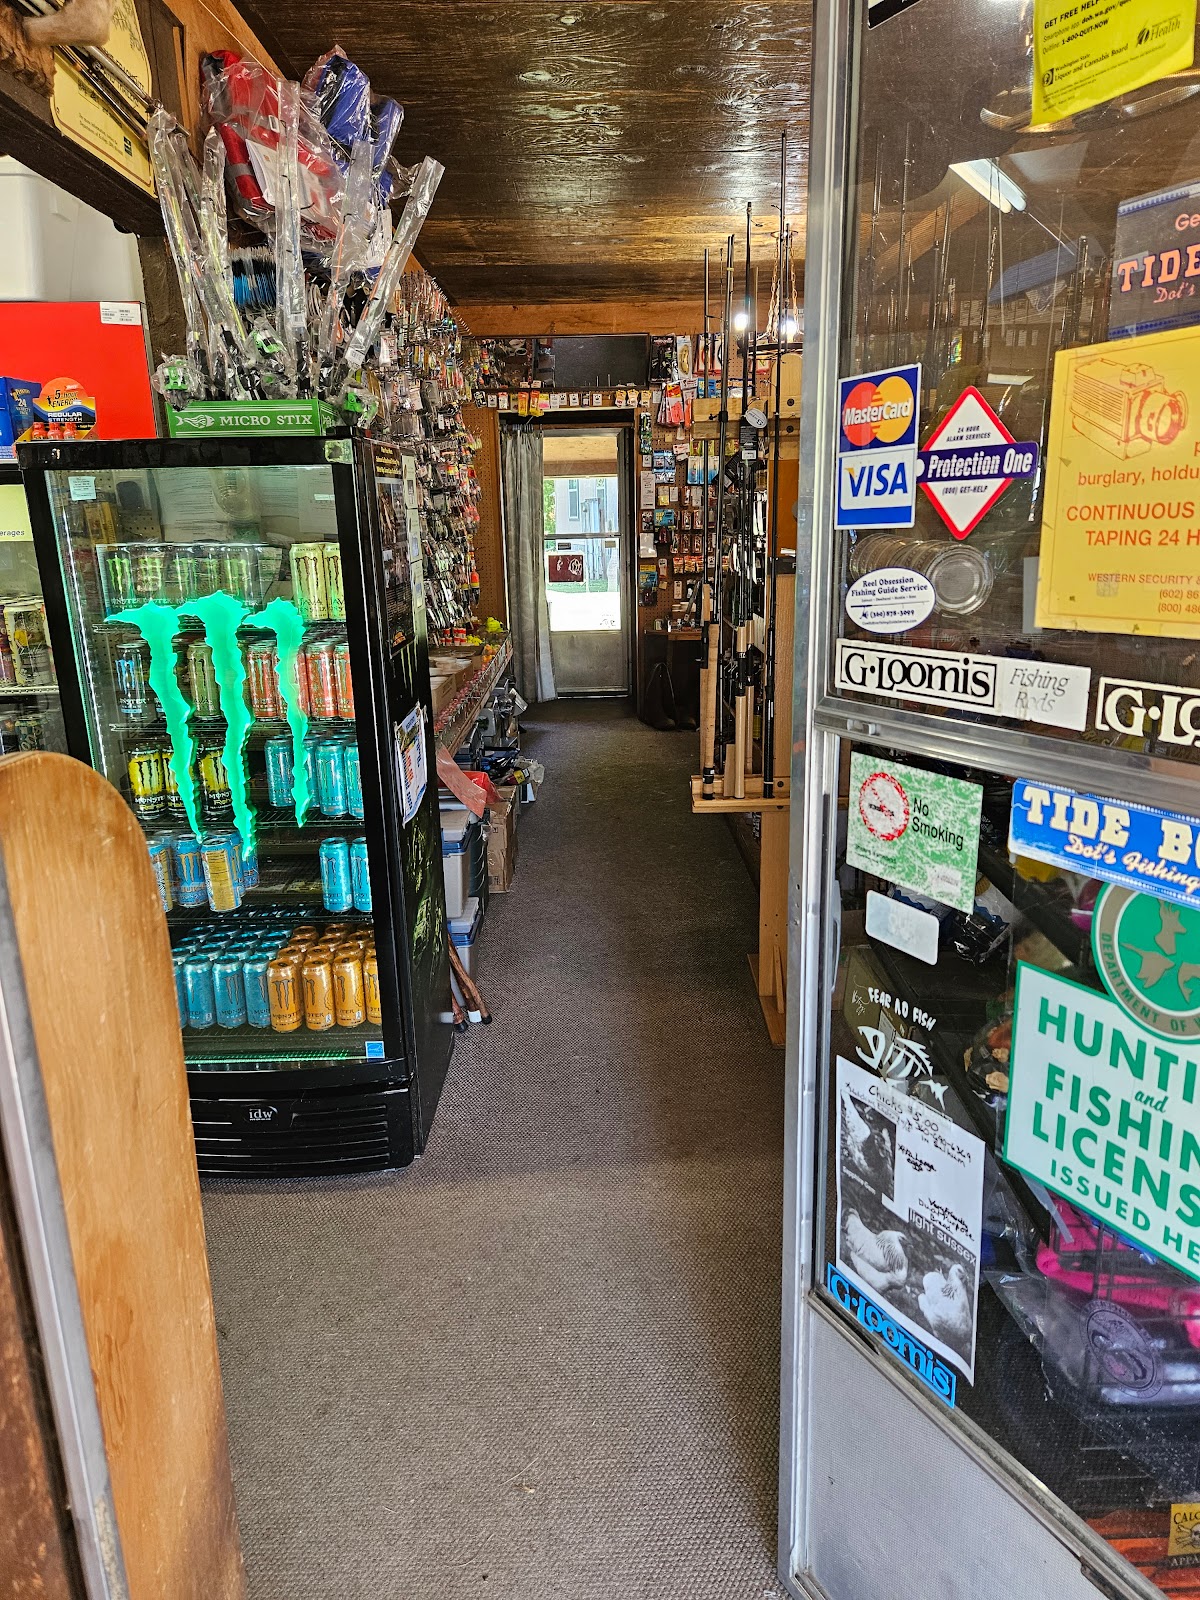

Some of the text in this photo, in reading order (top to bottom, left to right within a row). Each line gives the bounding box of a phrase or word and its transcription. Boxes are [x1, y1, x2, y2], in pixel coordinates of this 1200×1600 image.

[1044, 16, 1059, 30] GET
[1060, 6, 1079, 22] FREE
[1150, 18, 1182, 41] Health
[1061, 18, 1109, 46] 1-800-QUIT-NOW
[1054, 69, 1073, 82] Liquor
[1073, 64, 1084, 75] and
[1084, 52, 1110, 69] Cannabis
[1111, 43, 1129, 57] Board
[1055, 56, 1080, 72] Washington
[1117, 243, 1200, 293] TIDE
[1153, 281, 1196, 304] Dot's
[219, 415, 271, 427] MICRO
[276, 414, 313, 425] STIX
[844, 397, 913, 427] MasterCard
[965, 432, 991, 441] SERVICES
[927, 448, 1034, 479] Protection One
[845, 462, 909, 498] VISA
[959, 485, 988, 494] GET-HELP
[1078, 469, 1145, 488] burglary,
[1066, 501, 1195, 522] CONTINUOUS
[1085, 529, 1152, 546] TAPING
[1158, 529, 1180, 546] 24
[851, 583, 928, 597] Fishing Guide Service
[862, 576, 914, 588] Reel Obsession
[1088, 573, 1136, 583] WESTERN
[1138, 574, 1193, 585] SECURITY
[1160, 589, 1183, 600] (602)
[1158, 603, 1182, 614] (800)
[1009, 668, 1070, 696] Fishing
[913, 798, 929, 816] No
[912, 816, 964, 852] Smoking
[1023, 785, 1200, 869] TIDE B
[1064, 833, 1200, 894] Dot's Fishing
[1102, 933, 1187, 1032] DEPARTMENT OF
[868, 987, 891, 1008] FEAR
[895, 998, 909, 1018] NO
[913, 1007, 937, 1031] FISH
[1038, 996, 1198, 1104] HUNTI
[868, 1085, 903, 1114] Chicks
[1134, 1087, 1169, 1113] and
[249, 1108, 273, 1119] idw
[1032, 1101, 1200, 1227] LICENS
[1051, 1159, 1200, 1266] ISSUED HE
[908, 1207, 977, 1265] light sussex
